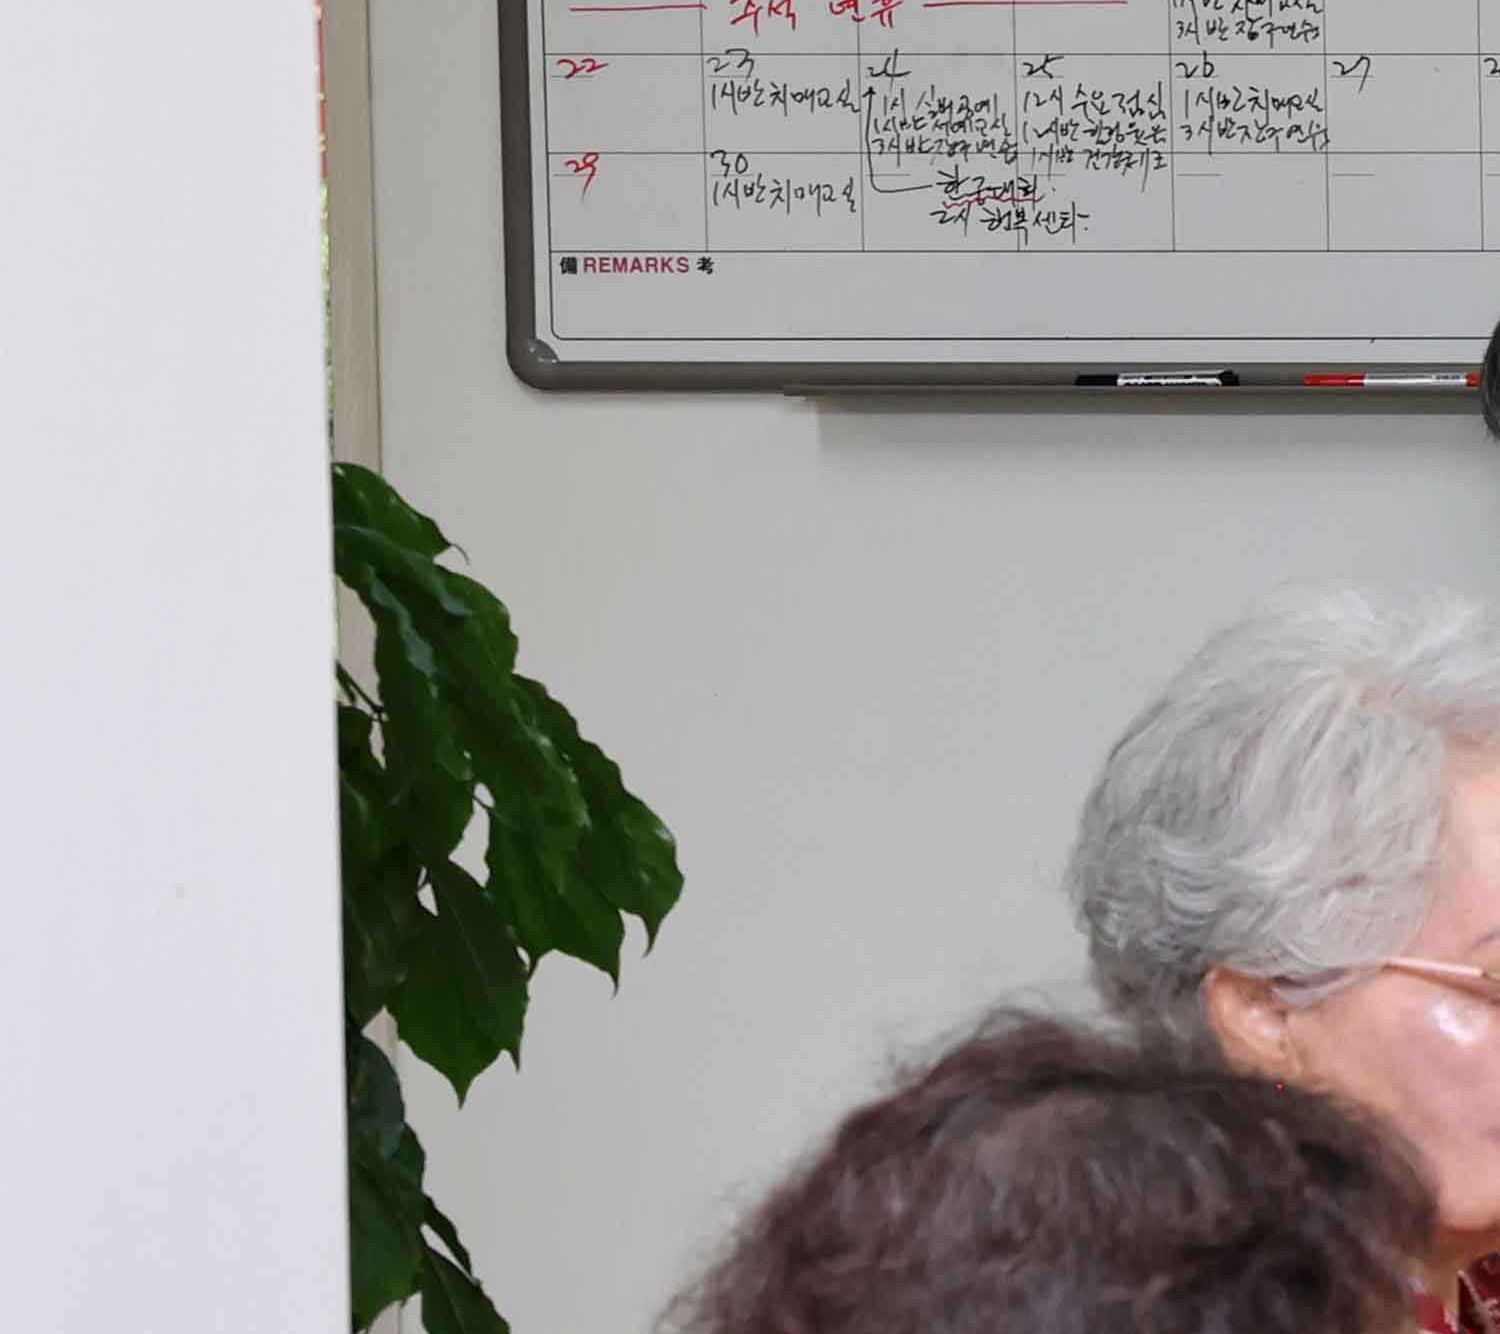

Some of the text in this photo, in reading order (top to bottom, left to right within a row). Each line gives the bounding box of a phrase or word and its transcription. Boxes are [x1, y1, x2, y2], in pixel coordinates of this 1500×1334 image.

[556, 58, 609, 80] 22
[707, 49, 755, 80] 23
[1022, 54, 1065, 80] 25
[1175, 51, 1215, 79] 26
[1332, 55, 1371, 94] 27
[564, 152, 600, 197] 29
[710, 149, 748, 175] 30
[583, 257, 690, 274] REMARKS
